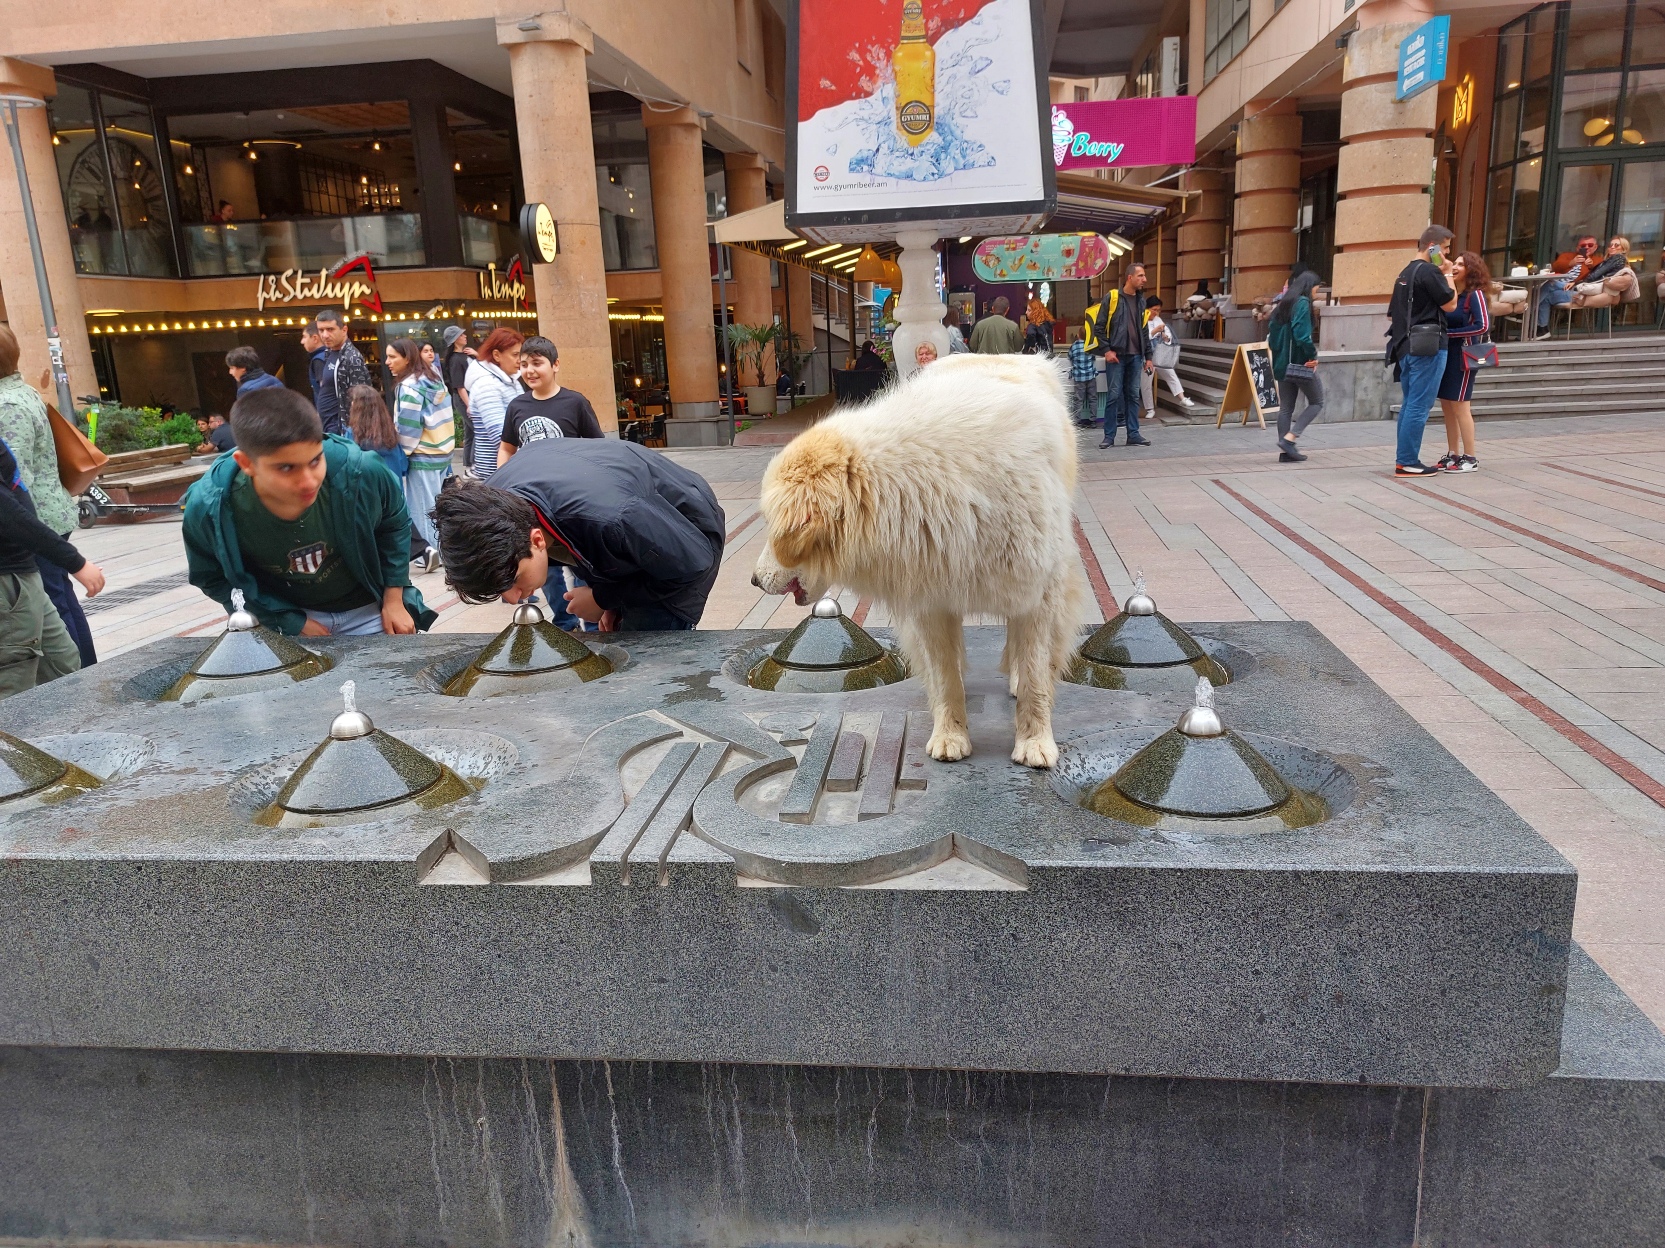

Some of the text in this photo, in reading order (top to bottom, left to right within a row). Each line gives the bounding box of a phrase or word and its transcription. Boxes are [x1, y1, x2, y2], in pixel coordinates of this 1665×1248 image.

[901, 113, 930, 122] GYUMRI
[1071, 131, 1125, 163] Berry
[813, 181, 888, 192] www.gyumribeer.am
[487, 262, 526, 312] Tempo
[89, 486, 108, 505] 1392
